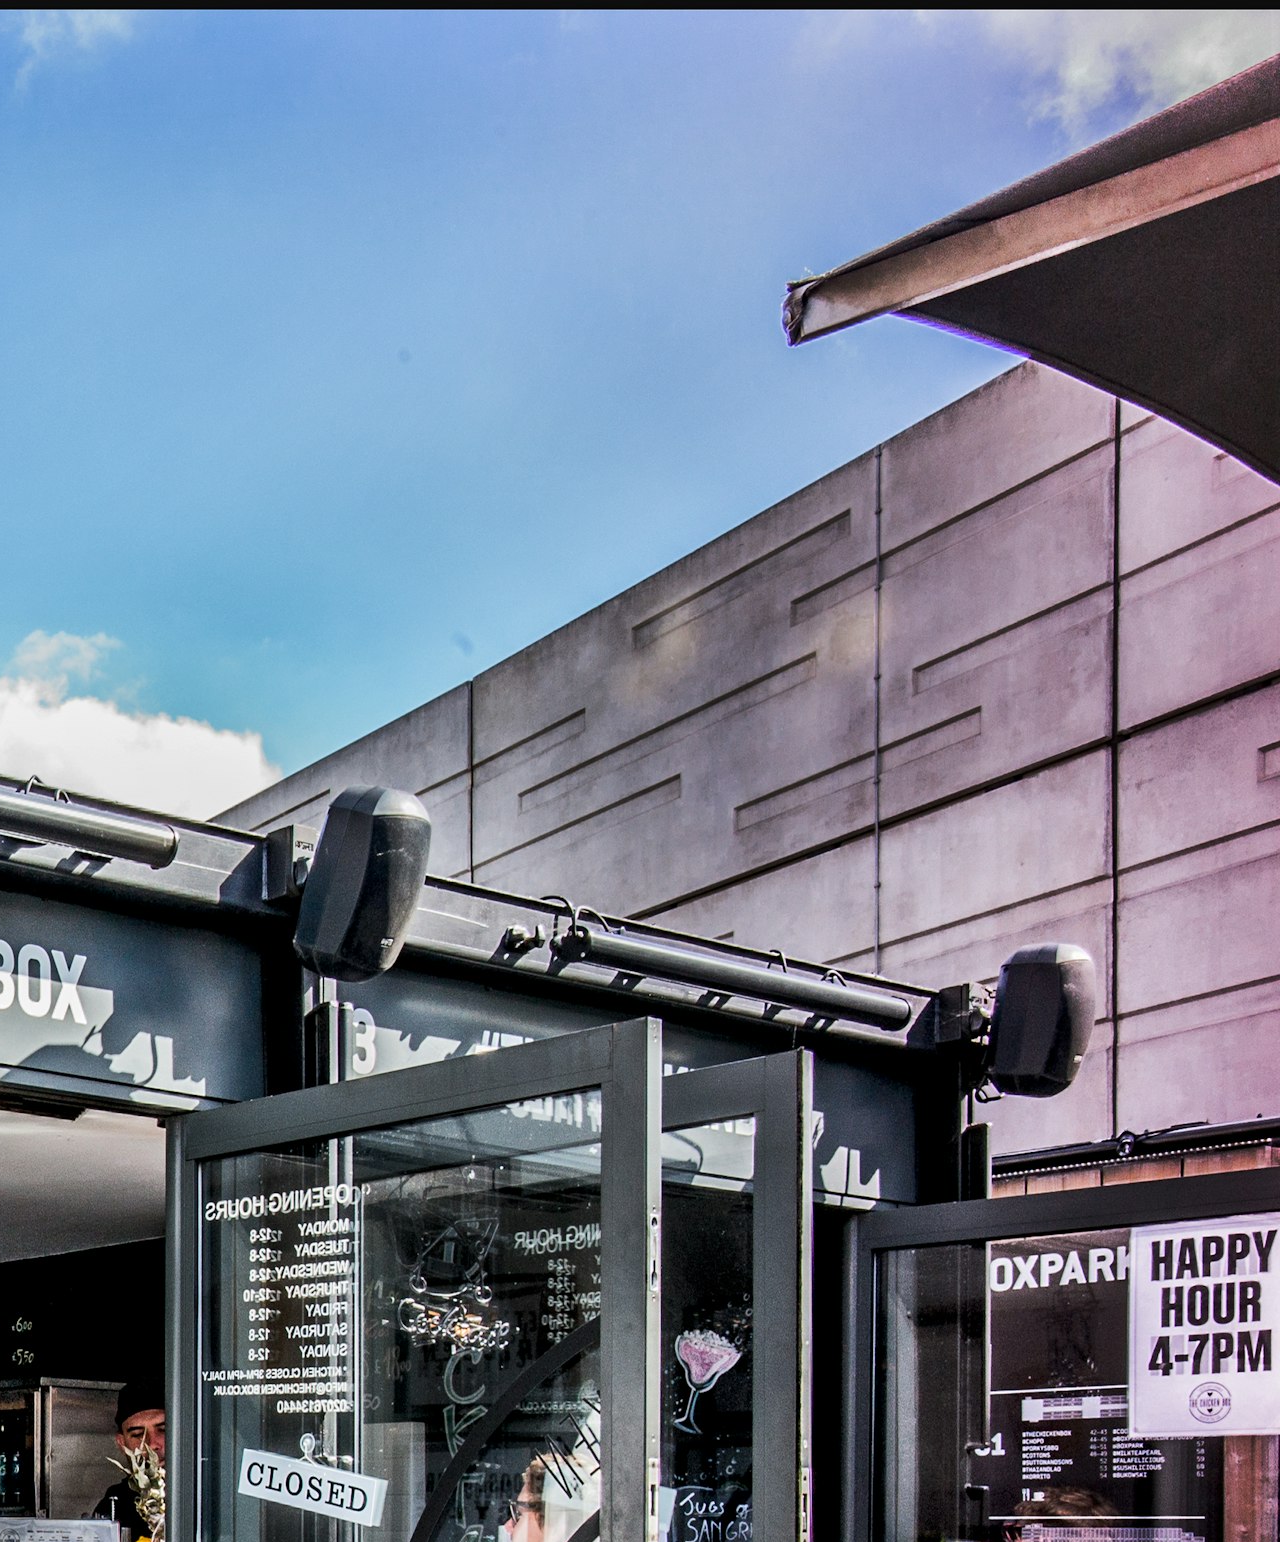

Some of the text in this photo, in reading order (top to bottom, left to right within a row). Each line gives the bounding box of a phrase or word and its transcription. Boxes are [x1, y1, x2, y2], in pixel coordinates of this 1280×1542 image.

[1151, 1230, 1278, 1282] HAPPY
[1161, 1280, 1261, 1328] HOUR
[1148, 1329, 1272, 1377] 4-7PM
[247, 1462, 368, 1512] CLOSED
